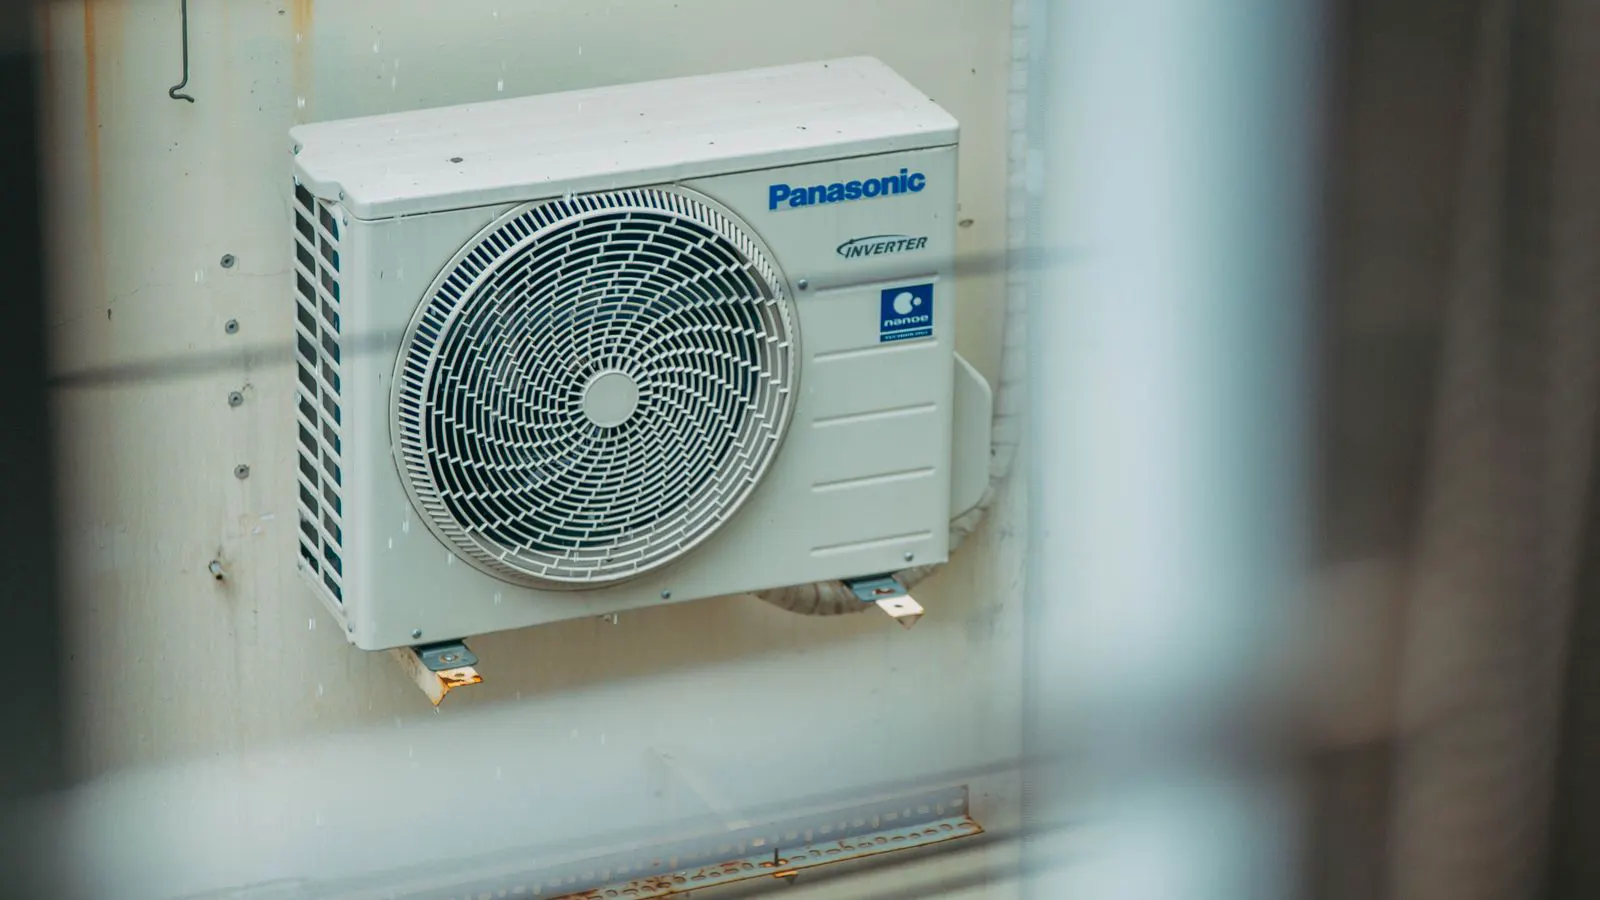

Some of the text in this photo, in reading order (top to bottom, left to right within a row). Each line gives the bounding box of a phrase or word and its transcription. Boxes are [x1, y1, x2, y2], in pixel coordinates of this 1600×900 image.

[769, 168, 926, 210] Panasonic
[843, 236, 928, 258] INVERTER
[883, 315, 929, 327] nanoe
